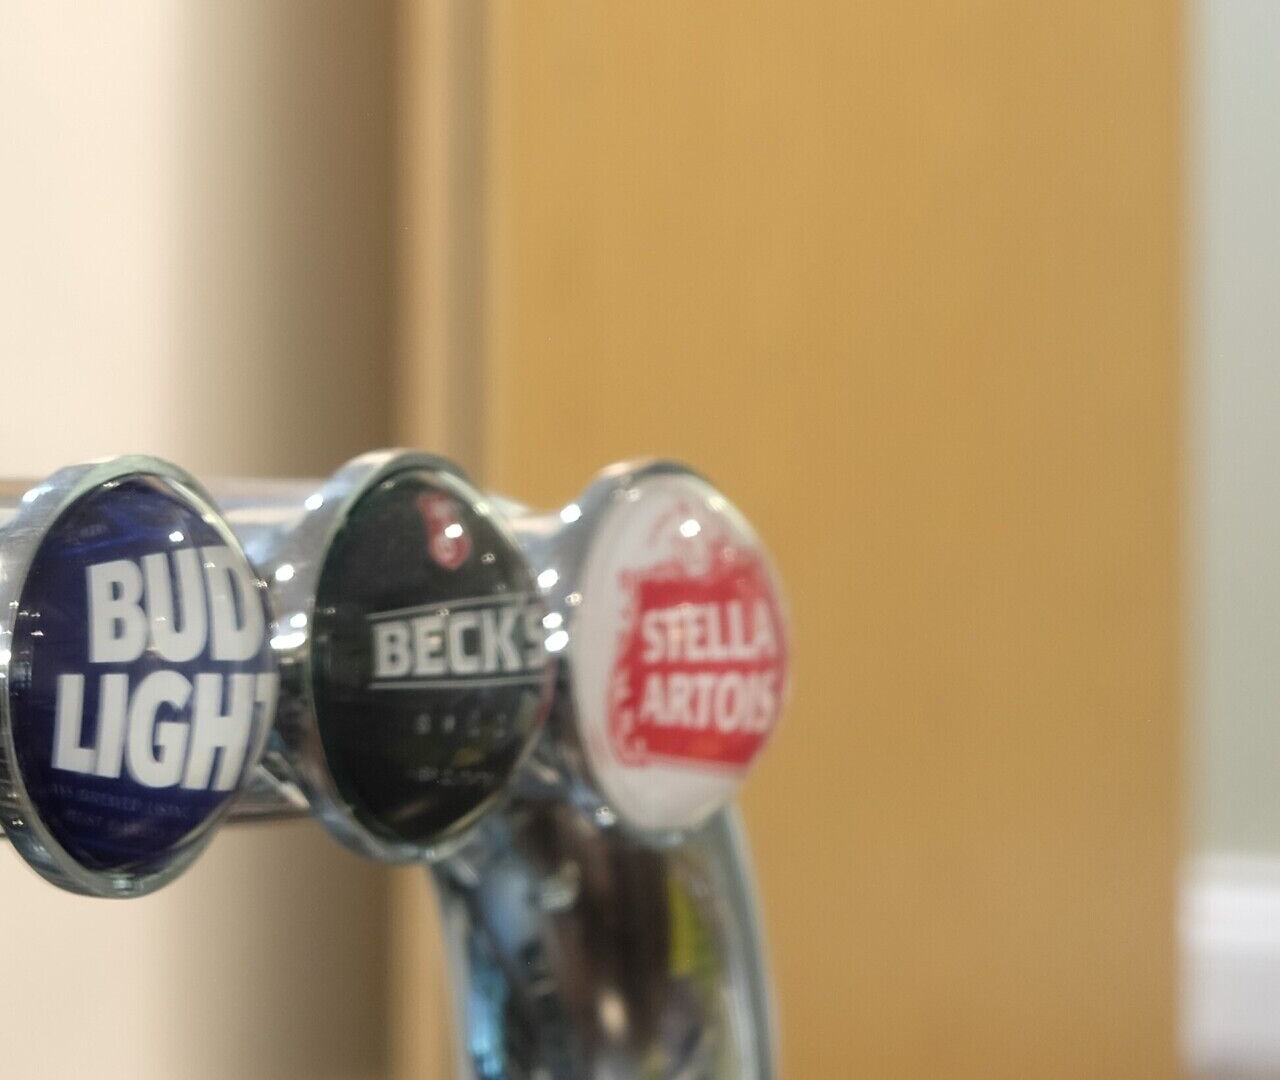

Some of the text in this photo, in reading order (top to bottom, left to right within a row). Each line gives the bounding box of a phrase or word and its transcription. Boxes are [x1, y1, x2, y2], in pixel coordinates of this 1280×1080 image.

[85, 545, 264, 664] BUD
[643, 597, 776, 663] STELLA
[640, 670, 776, 735] ARTOIS
